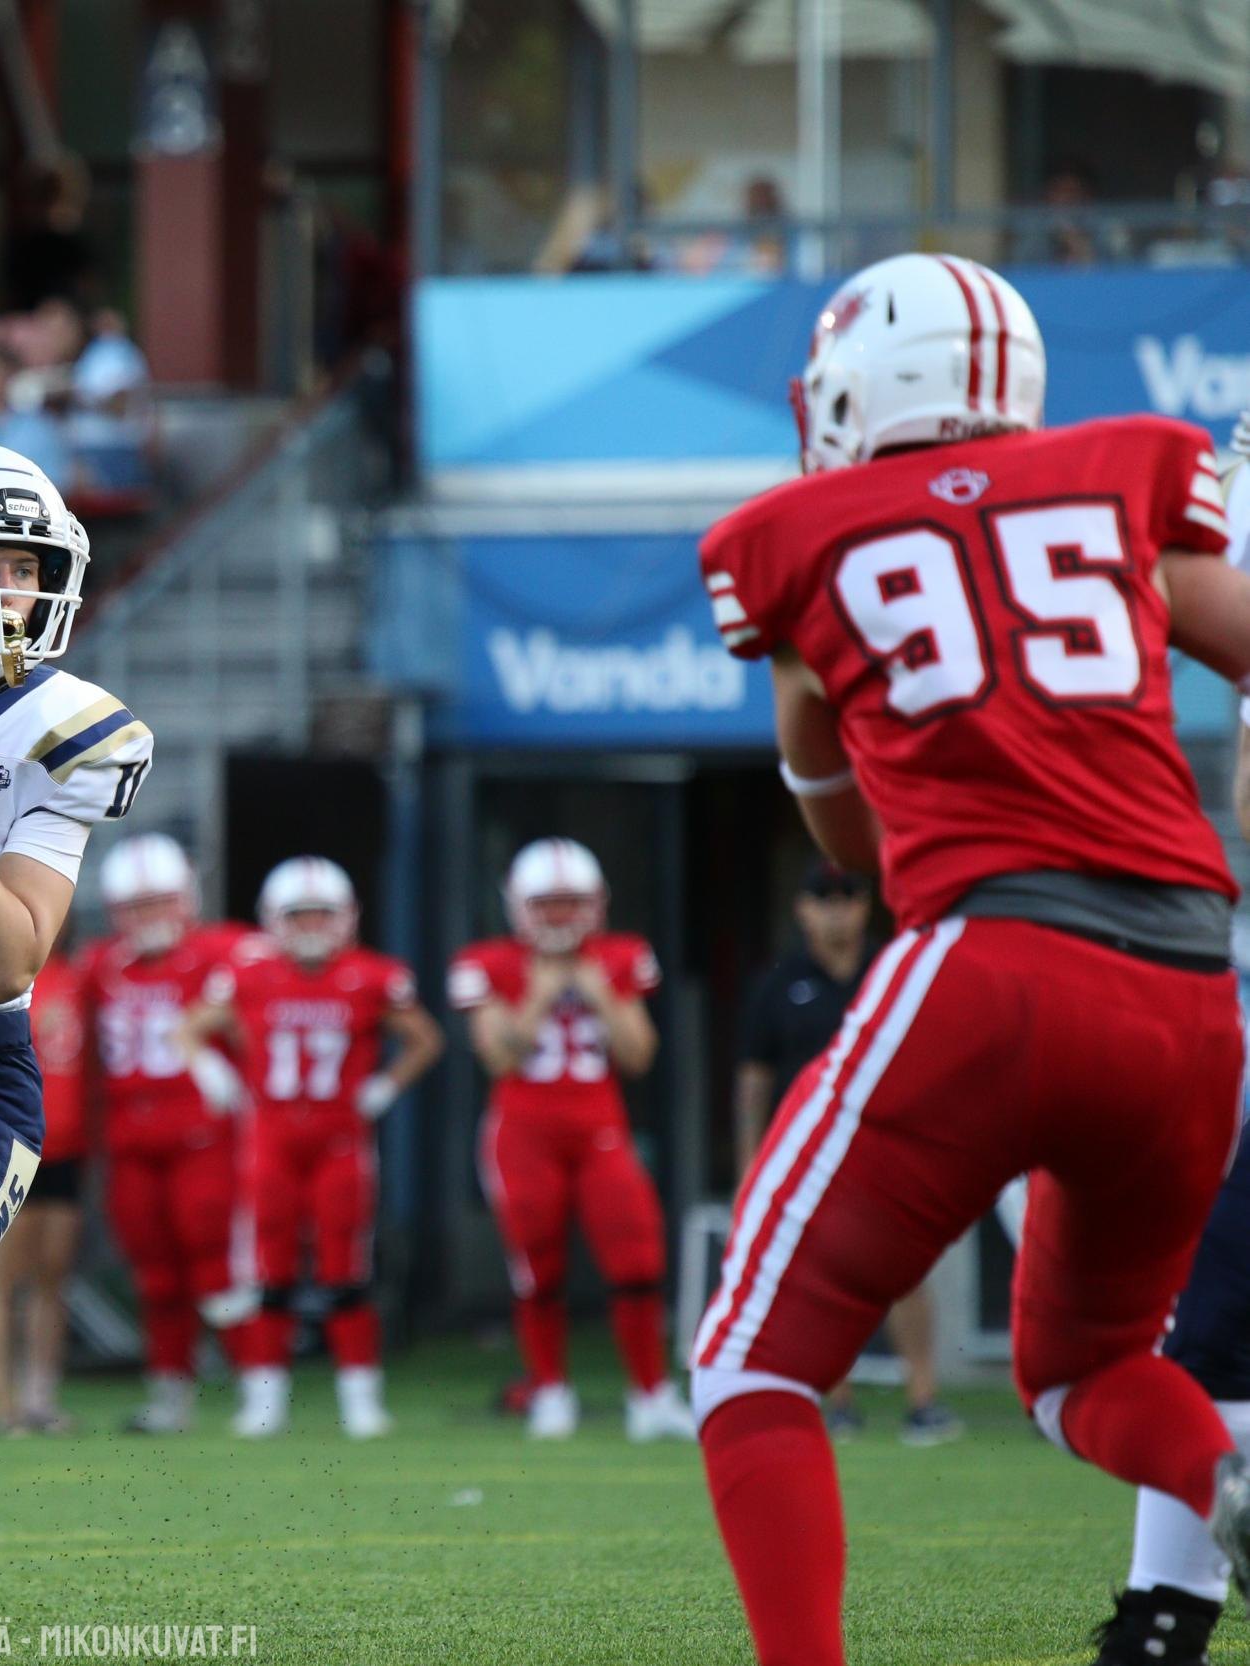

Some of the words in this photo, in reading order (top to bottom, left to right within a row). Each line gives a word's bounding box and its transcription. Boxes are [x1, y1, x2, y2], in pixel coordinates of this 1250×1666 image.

[8, 503, 38, 513] schutt
[829, 496, 1145, 725] 95
[490, 626, 746, 713] Vanda
[263, 1029, 352, 1101] 17
